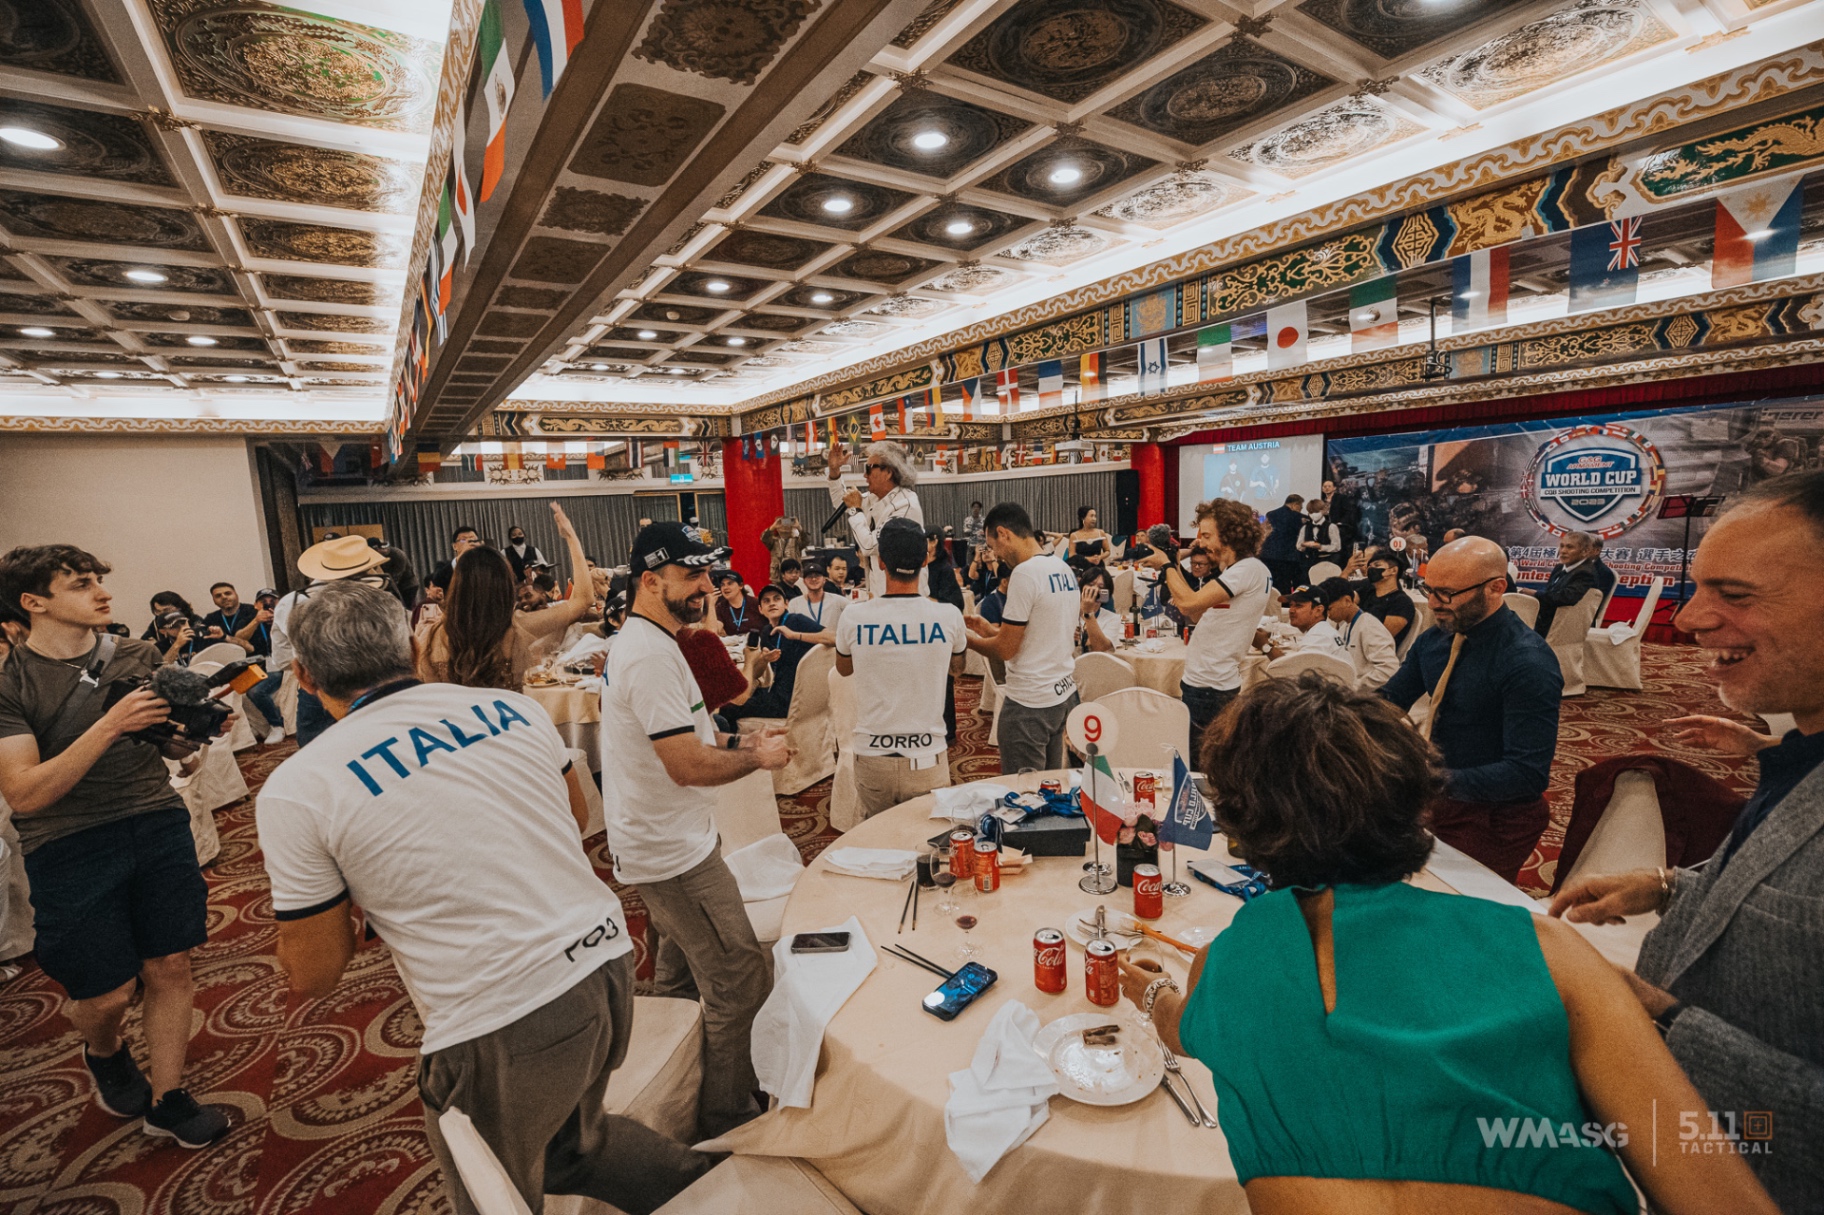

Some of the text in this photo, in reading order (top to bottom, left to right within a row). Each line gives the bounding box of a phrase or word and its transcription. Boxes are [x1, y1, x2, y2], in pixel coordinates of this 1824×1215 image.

[1227, 441, 1280, 452] TEAM AUSTRIA
[1545, 470, 1637, 487] WORLD CUP
[1619, 573, 1674, 587] eptin
[857, 622, 947, 646] ITALIA
[1084, 715, 1102, 743] 9
[346, 700, 532, 797] ITALIA
[869, 733, 932, 749] ZORRO
